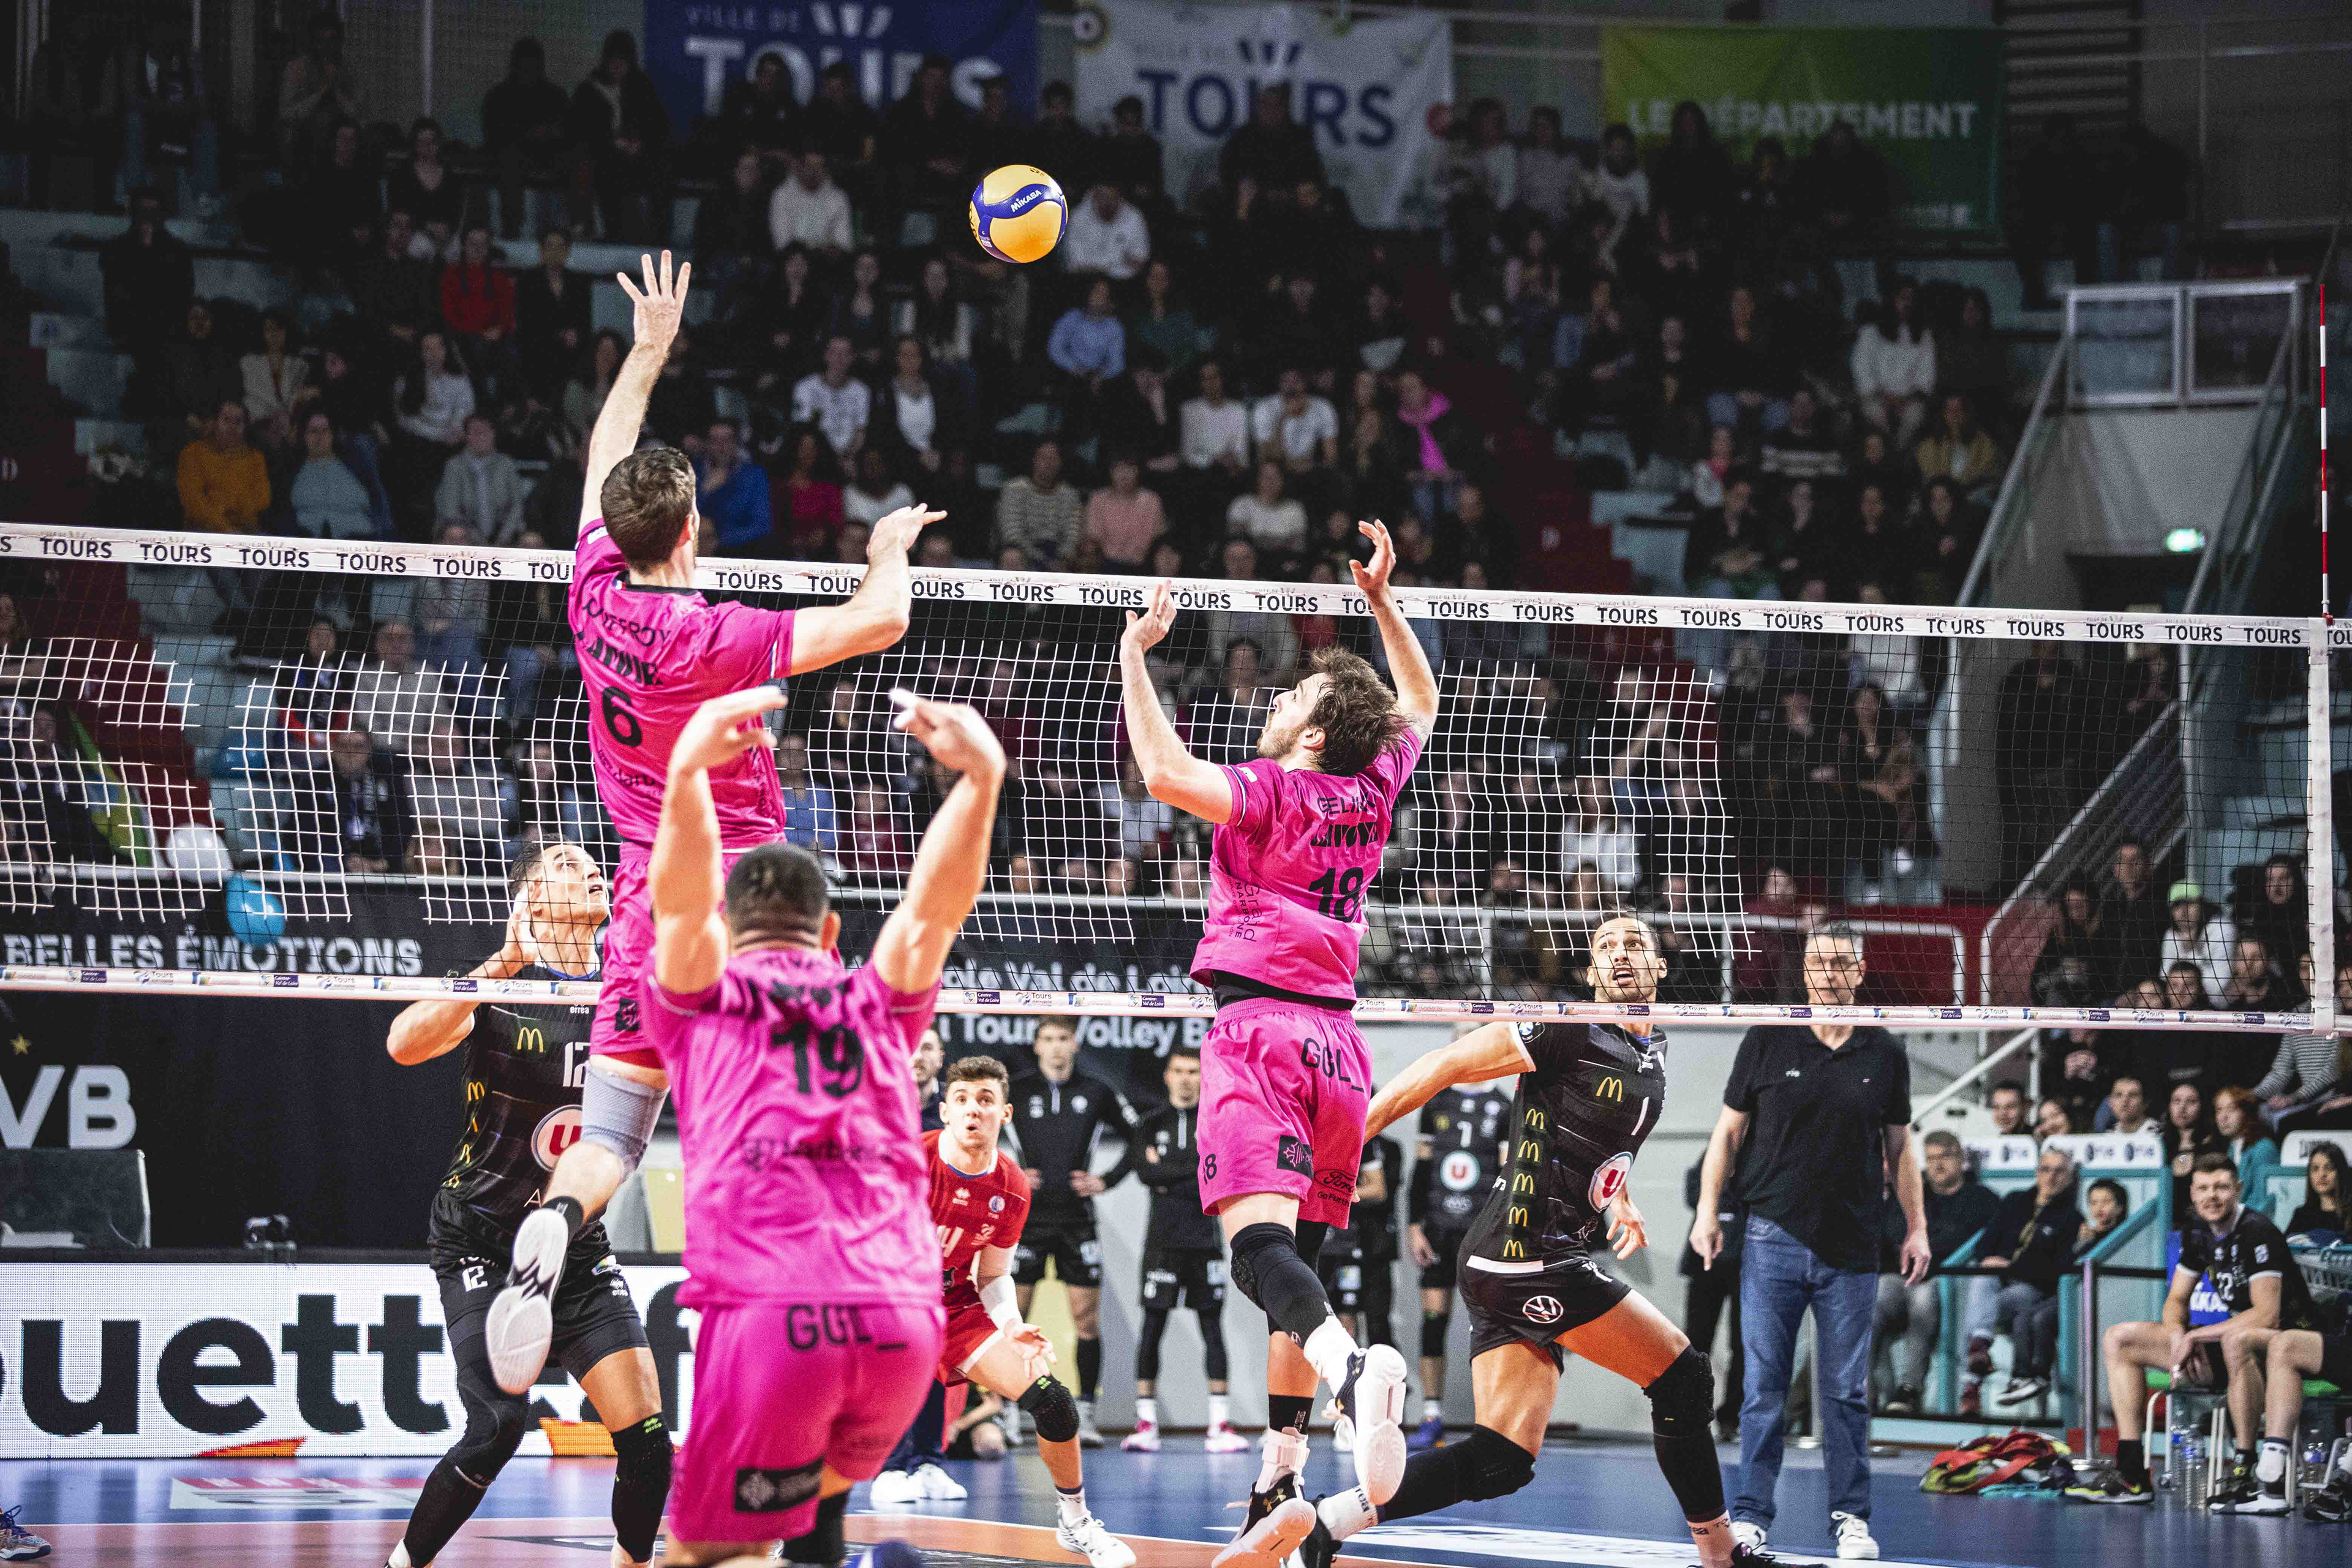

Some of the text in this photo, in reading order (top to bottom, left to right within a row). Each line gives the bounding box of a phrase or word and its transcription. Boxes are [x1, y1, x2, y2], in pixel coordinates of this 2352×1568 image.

[1011, 190, 1042, 213] MIKASA
[40, 537, 111, 558] TOURS
[140, 544, 211, 563] TOURS
[239, 549, 309, 568] TOURS
[337, 553, 406, 573] TOURS
[433, 559, 501, 576] TOURS
[716, 572, 782, 590] TOURS
[807, 576, 861, 593] TOUR
[912, 581, 964, 598] OURS
[990, 584, 1054, 601] TOURS
[1079, 589, 1142, 605] TOURS
[1255, 595, 1317, 612] TOURS
[1428, 601, 1488, 618] TOURS
[1513, 605, 1574, 620] TOURS
[1597, 608, 1657, 624] TOURS
[1681, 611, 1741, 627] TOURS
[1763, 613, 1823, 630] TOURS
[1845, 616, 1903, 631] TOURS
[1926, 617, 1985, 634] TOURS
[2007, 620, 2064, 636] TOURS
[2086, 622, 2144, 639] TOURS
[2165, 625, 2222, 641] TOURS
[2244, 628, 2301, 644] TOURS
[601, 687, 643, 747] 6
[1308, 867, 1364, 922] 18
[3, 934, 164, 969] BELLES
[771, 1022, 864, 1097] 19
[462, 1265, 488, 1292] 12
